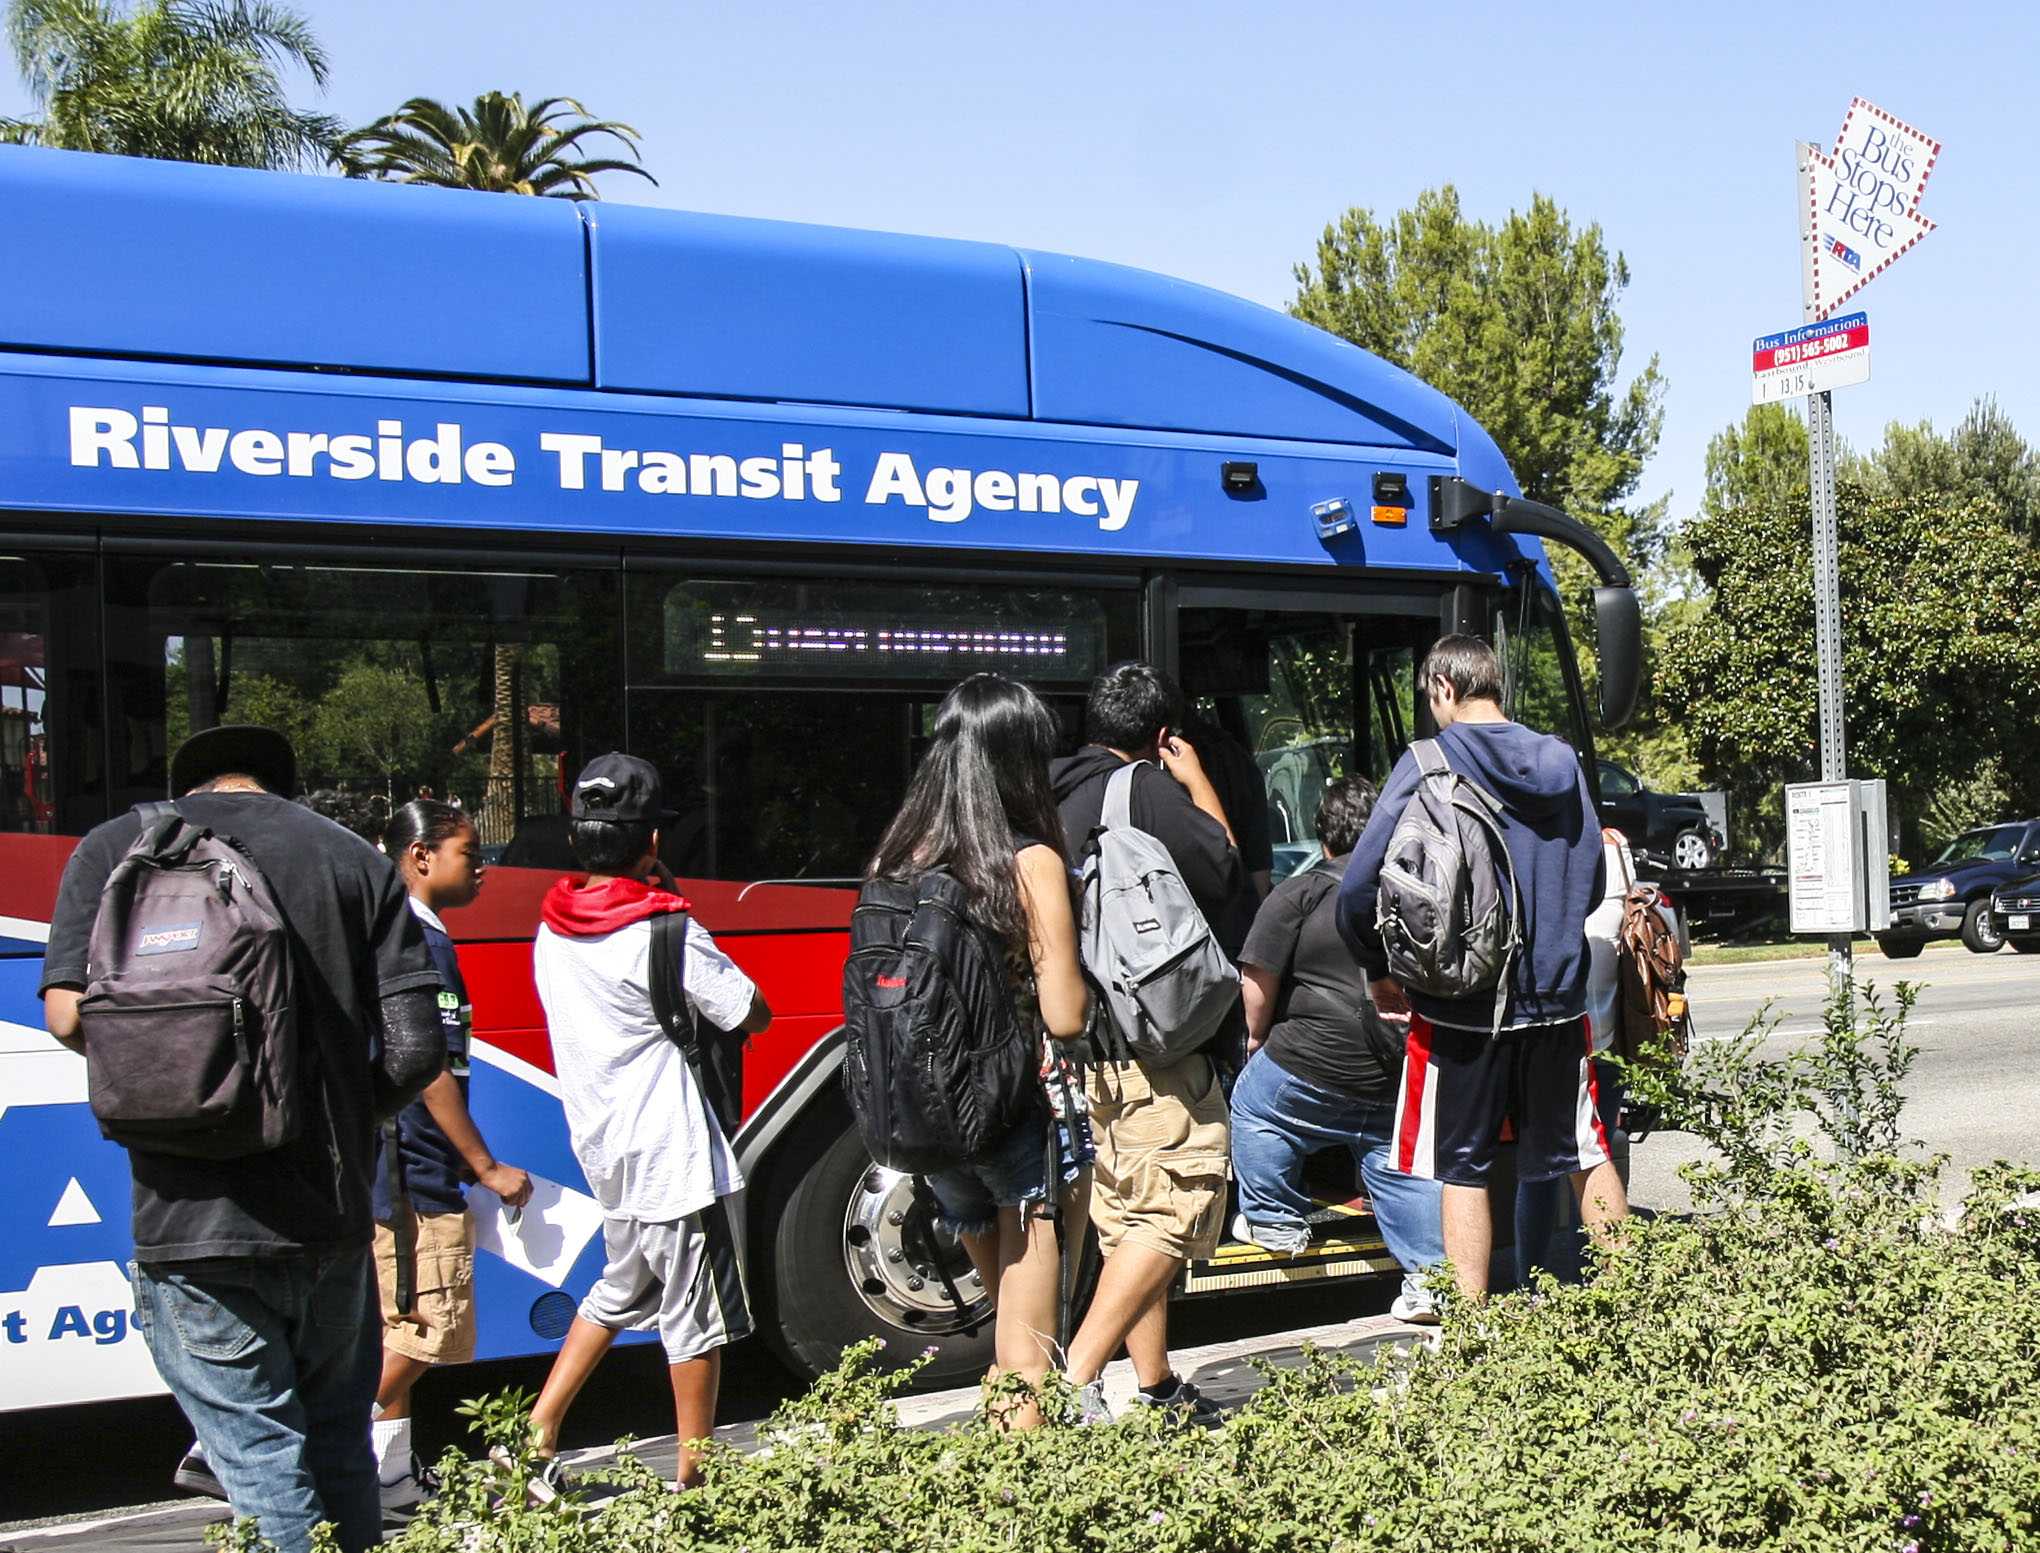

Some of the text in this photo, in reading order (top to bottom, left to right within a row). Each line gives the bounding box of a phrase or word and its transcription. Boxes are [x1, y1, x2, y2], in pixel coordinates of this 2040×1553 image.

[1857, 124, 1915, 184] Bus
[1889, 133, 1914, 156] the
[1834, 147, 1909, 217] Stops
[1823, 180, 1894, 249] Here
[1755, 339, 1780, 352] Bus
[1773, 345, 1801, 367] (951)
[68, 405, 1140, 532] Riverside Transit Agency
